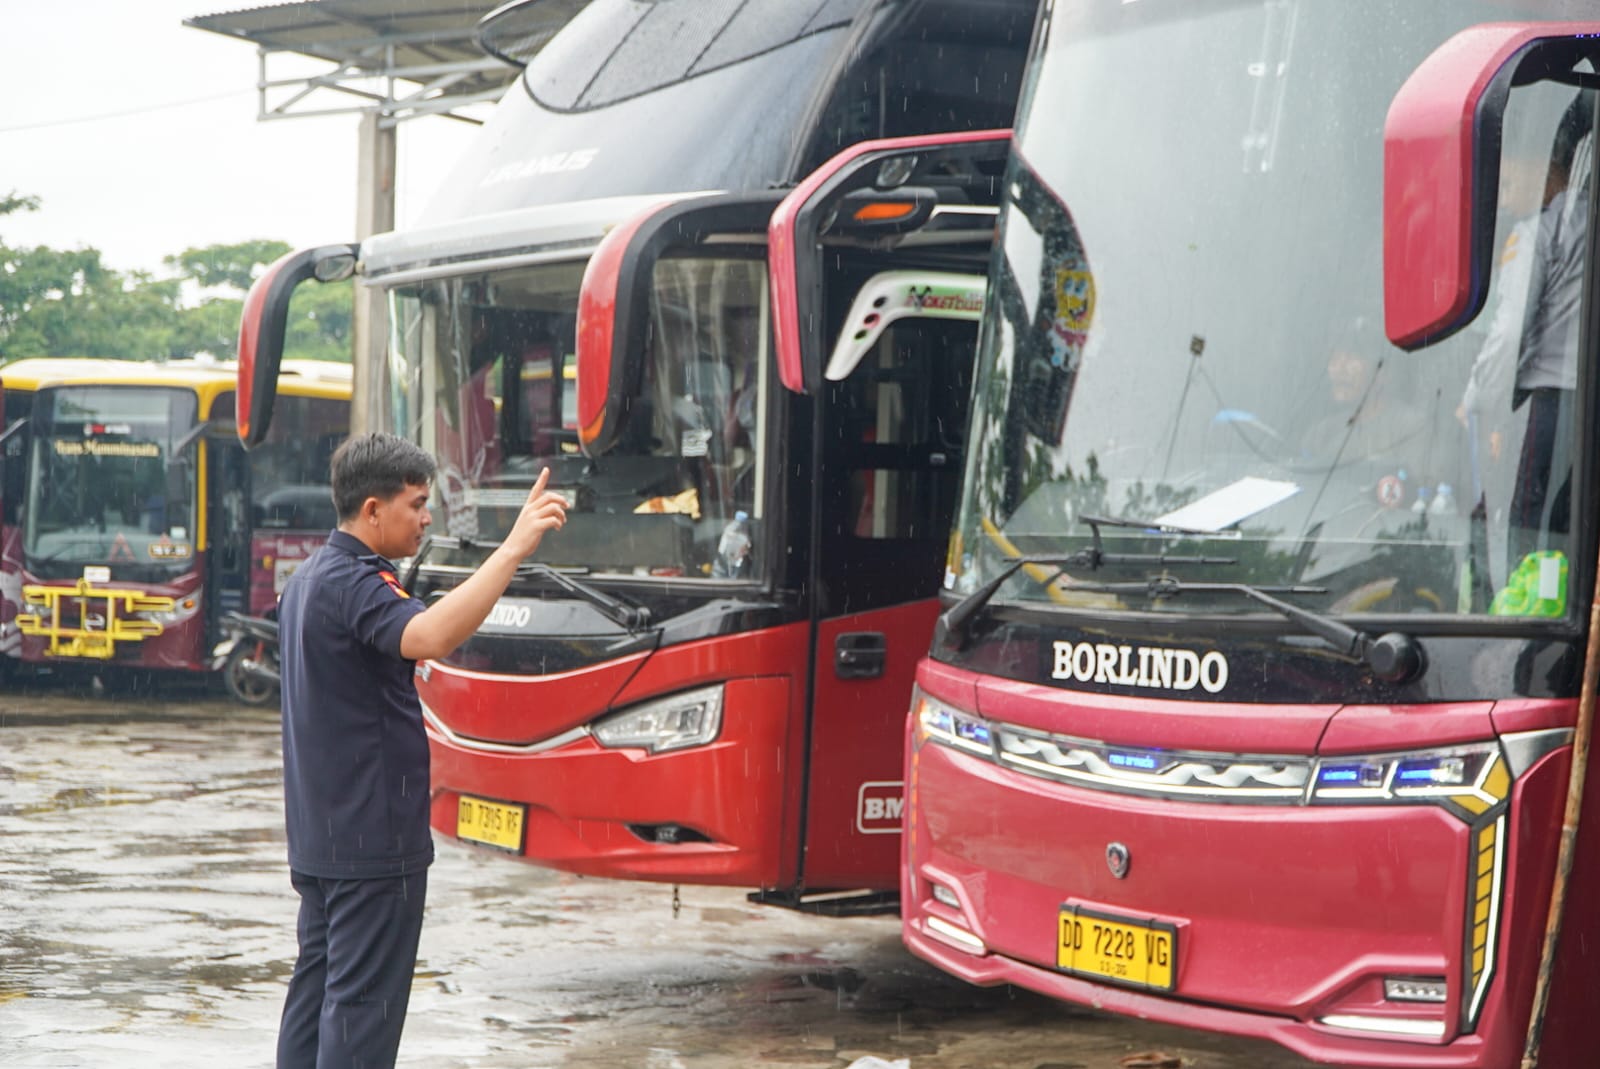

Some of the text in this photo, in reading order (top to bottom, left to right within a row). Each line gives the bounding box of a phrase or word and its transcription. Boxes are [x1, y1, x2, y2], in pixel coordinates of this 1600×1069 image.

[485, 604, 531, 628] INDO
[1052, 640, 1229, 694] BORLINDO
[1063, 919, 1168, 967] DD 7228 VG
